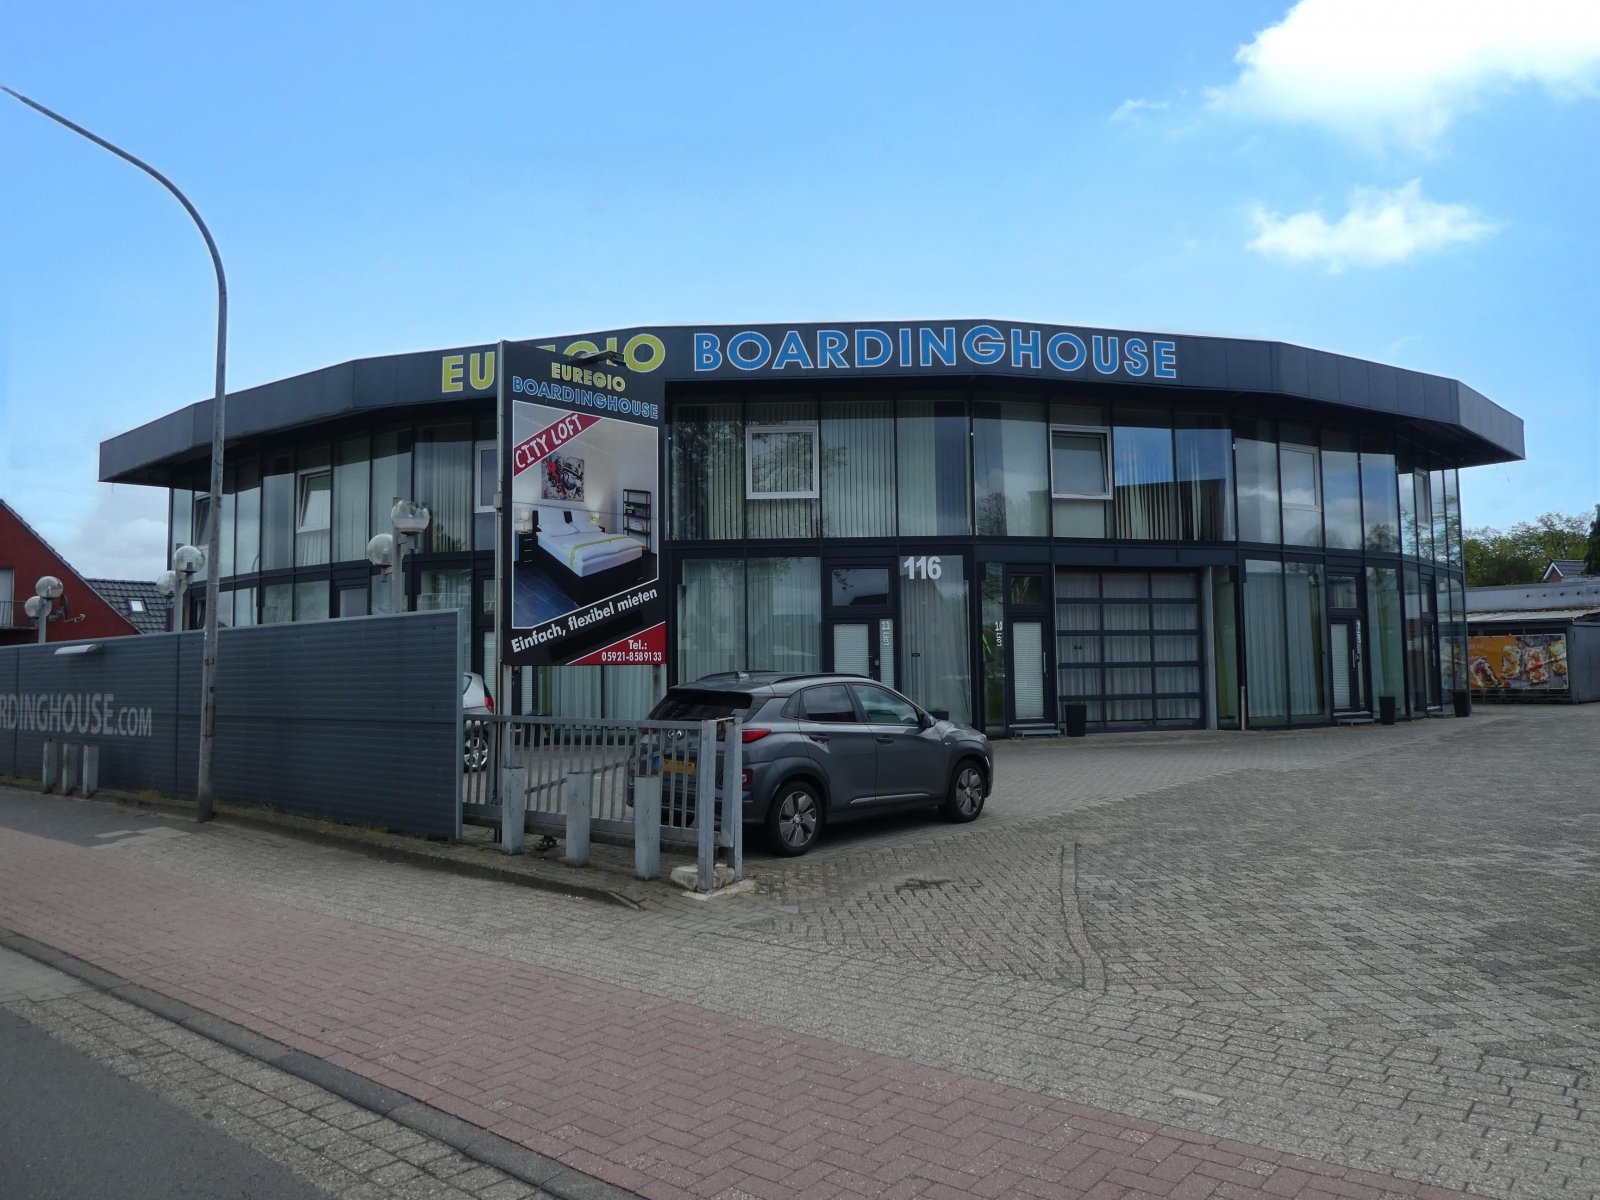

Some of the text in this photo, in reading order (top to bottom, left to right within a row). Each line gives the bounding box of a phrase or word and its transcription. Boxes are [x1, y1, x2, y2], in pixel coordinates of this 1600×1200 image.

[441, 325, 1177, 393] EUIO BOARDINGHOUSE
[551, 362, 626, 392] EUREGIO
[512, 375, 659, 419] BOARDINGHOUSE
[515, 414, 582, 468] CITY LOFT
[903, 556, 942, 580] 116
[511, 588, 658, 653] Einfach, flexibel mieten
[601, 651, 662, 662] 05921-8589133
[628, 639, 648, 650] Tel.:
